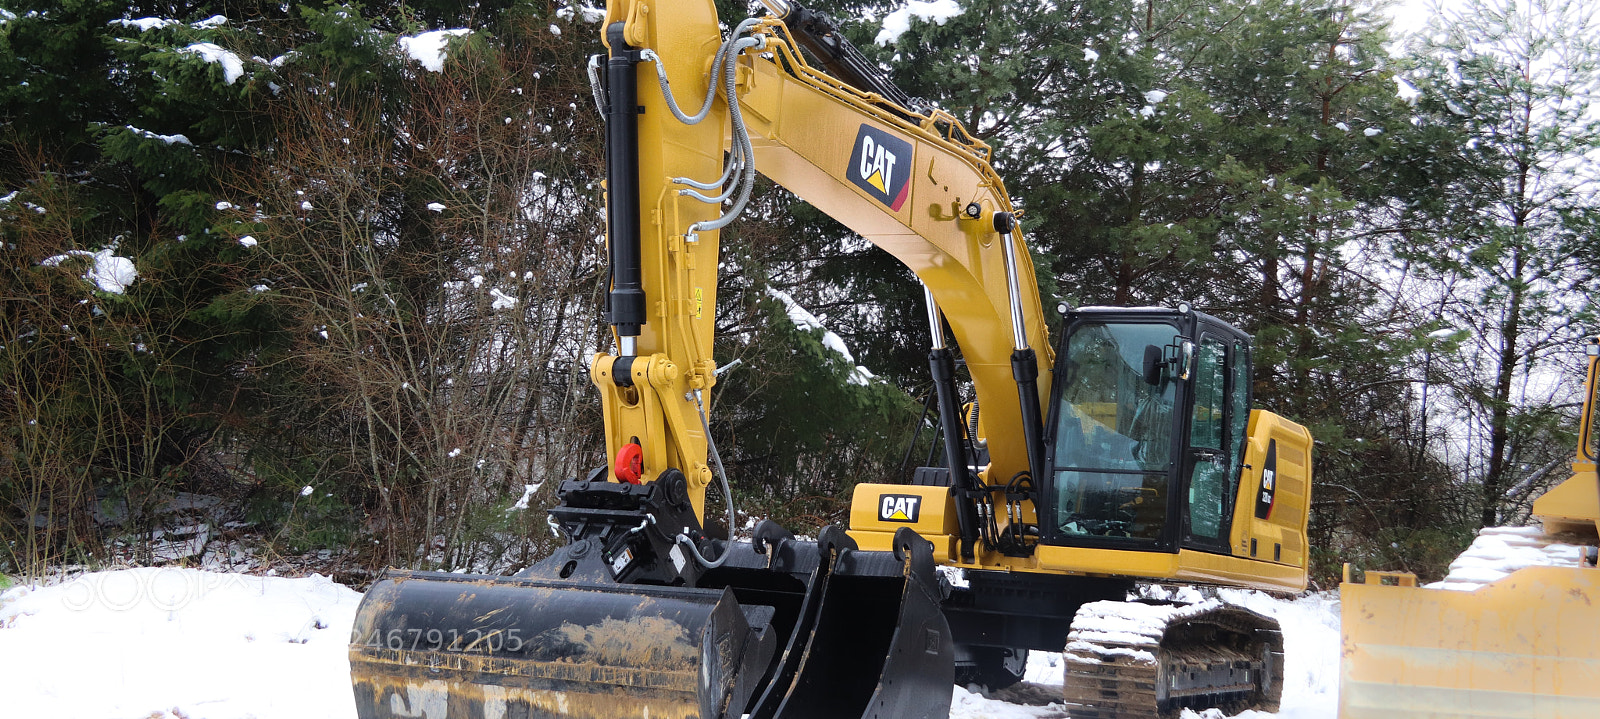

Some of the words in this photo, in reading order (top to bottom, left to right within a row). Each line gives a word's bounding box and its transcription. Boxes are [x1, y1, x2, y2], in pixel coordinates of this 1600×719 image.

[860, 135, 896, 196] CAT
[1263, 468, 1274, 490] CAT
[881, 496, 917, 520] CAT
